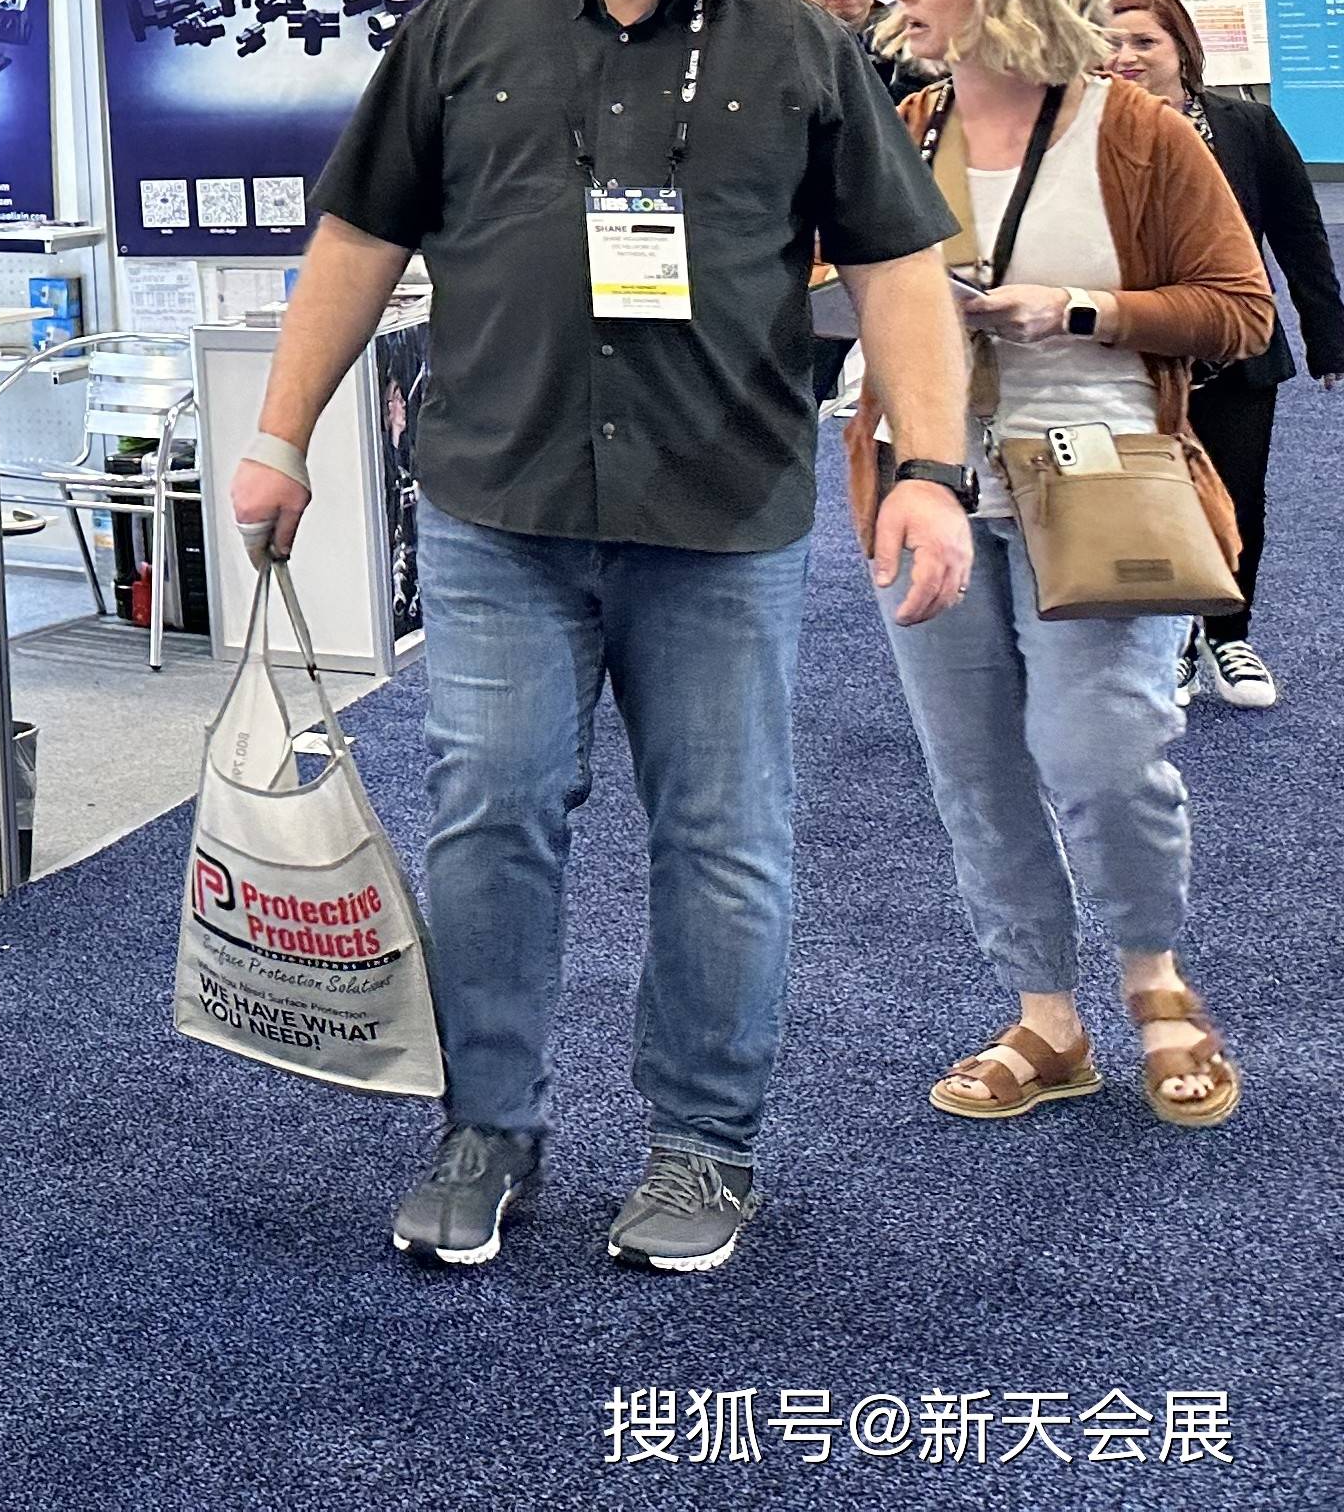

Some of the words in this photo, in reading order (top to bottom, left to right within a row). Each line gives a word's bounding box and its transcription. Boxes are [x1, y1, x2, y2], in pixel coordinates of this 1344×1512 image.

[240, 880, 382, 926] Protective
[247, 914, 381, 958] Products
[198, 992, 242, 1029] YOU
[248, 1016, 321, 1051] NEED!
[199, 971, 230, 1005] WE
[233, 992, 298, 1028] HAVE
[300, 1013, 380, 1042] WHAT
